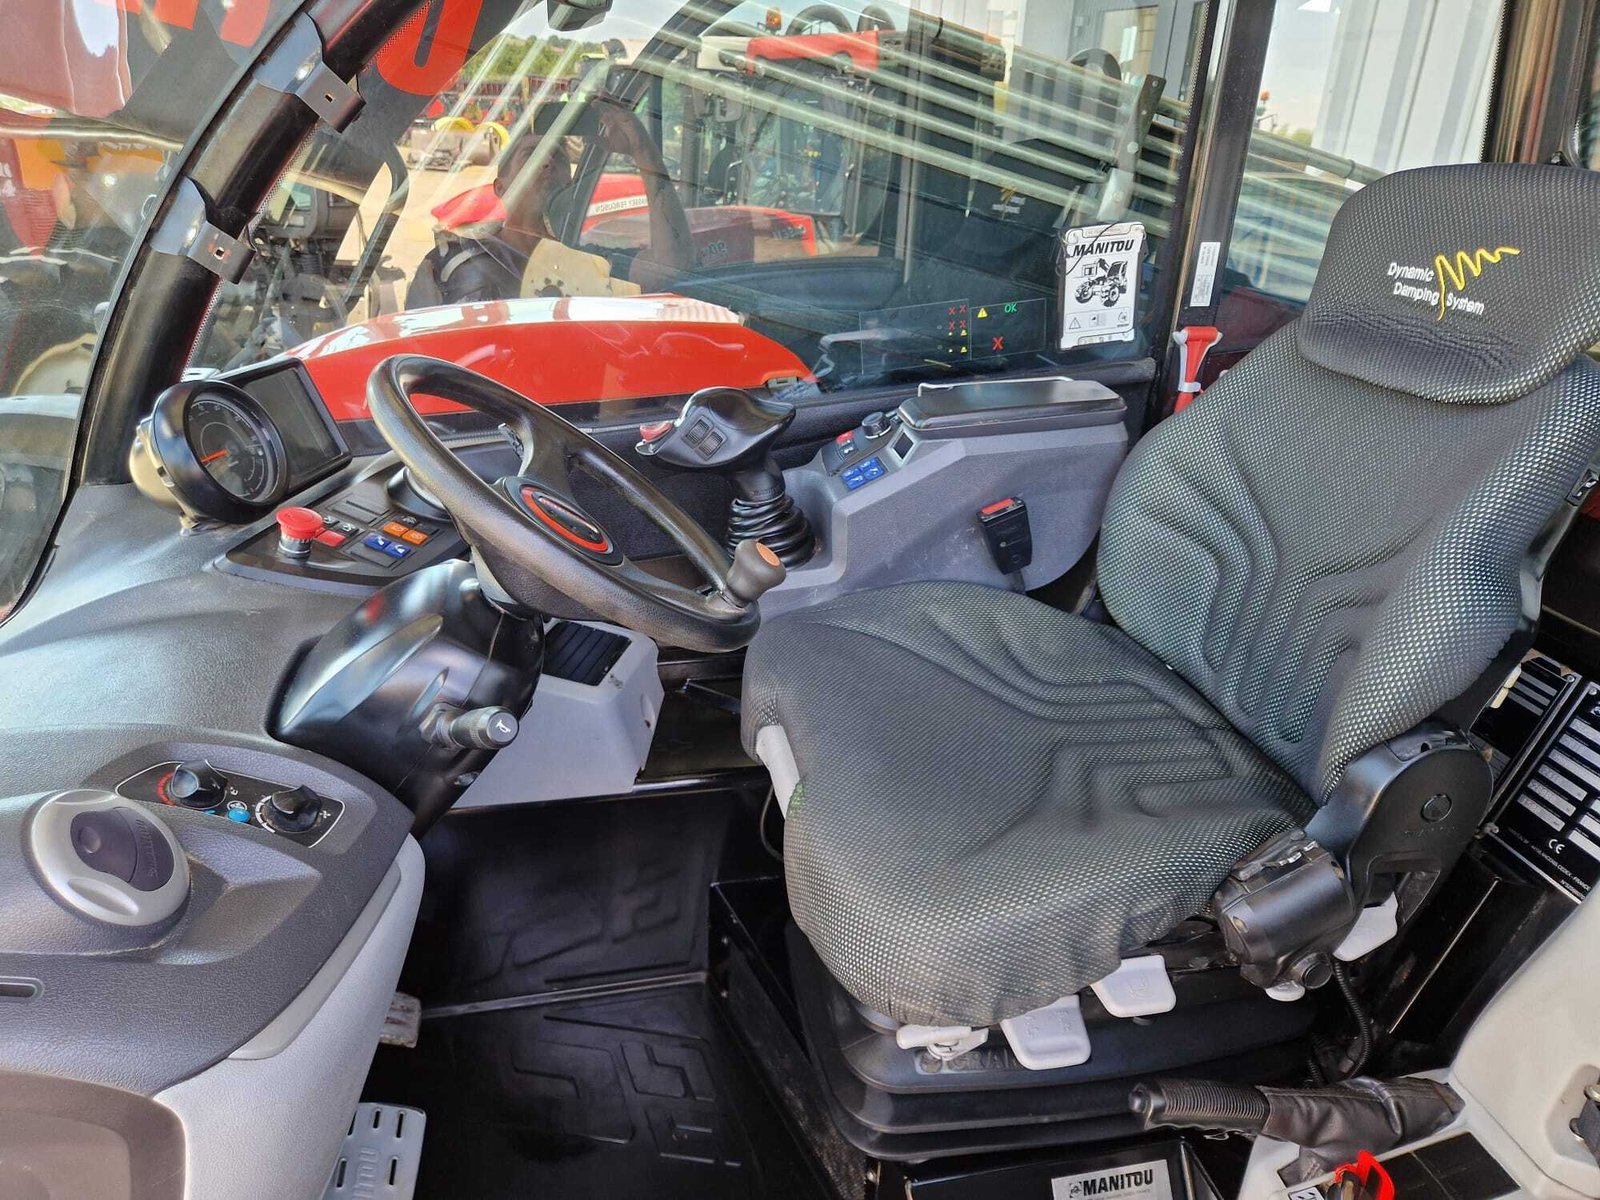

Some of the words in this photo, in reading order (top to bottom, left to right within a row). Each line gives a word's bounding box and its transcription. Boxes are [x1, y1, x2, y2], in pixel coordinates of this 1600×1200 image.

[1072, 239, 1135, 257] MANITOU
[1387, 262, 1435, 282] Dynamic
[1004, 302, 1018, 313] OK
[1393, 282, 1440, 306] Damping
[1446, 292, 1485, 315] System
[1548, 838, 1565, 854] CE
[1083, 1169, 1153, 1197] MANITOU
